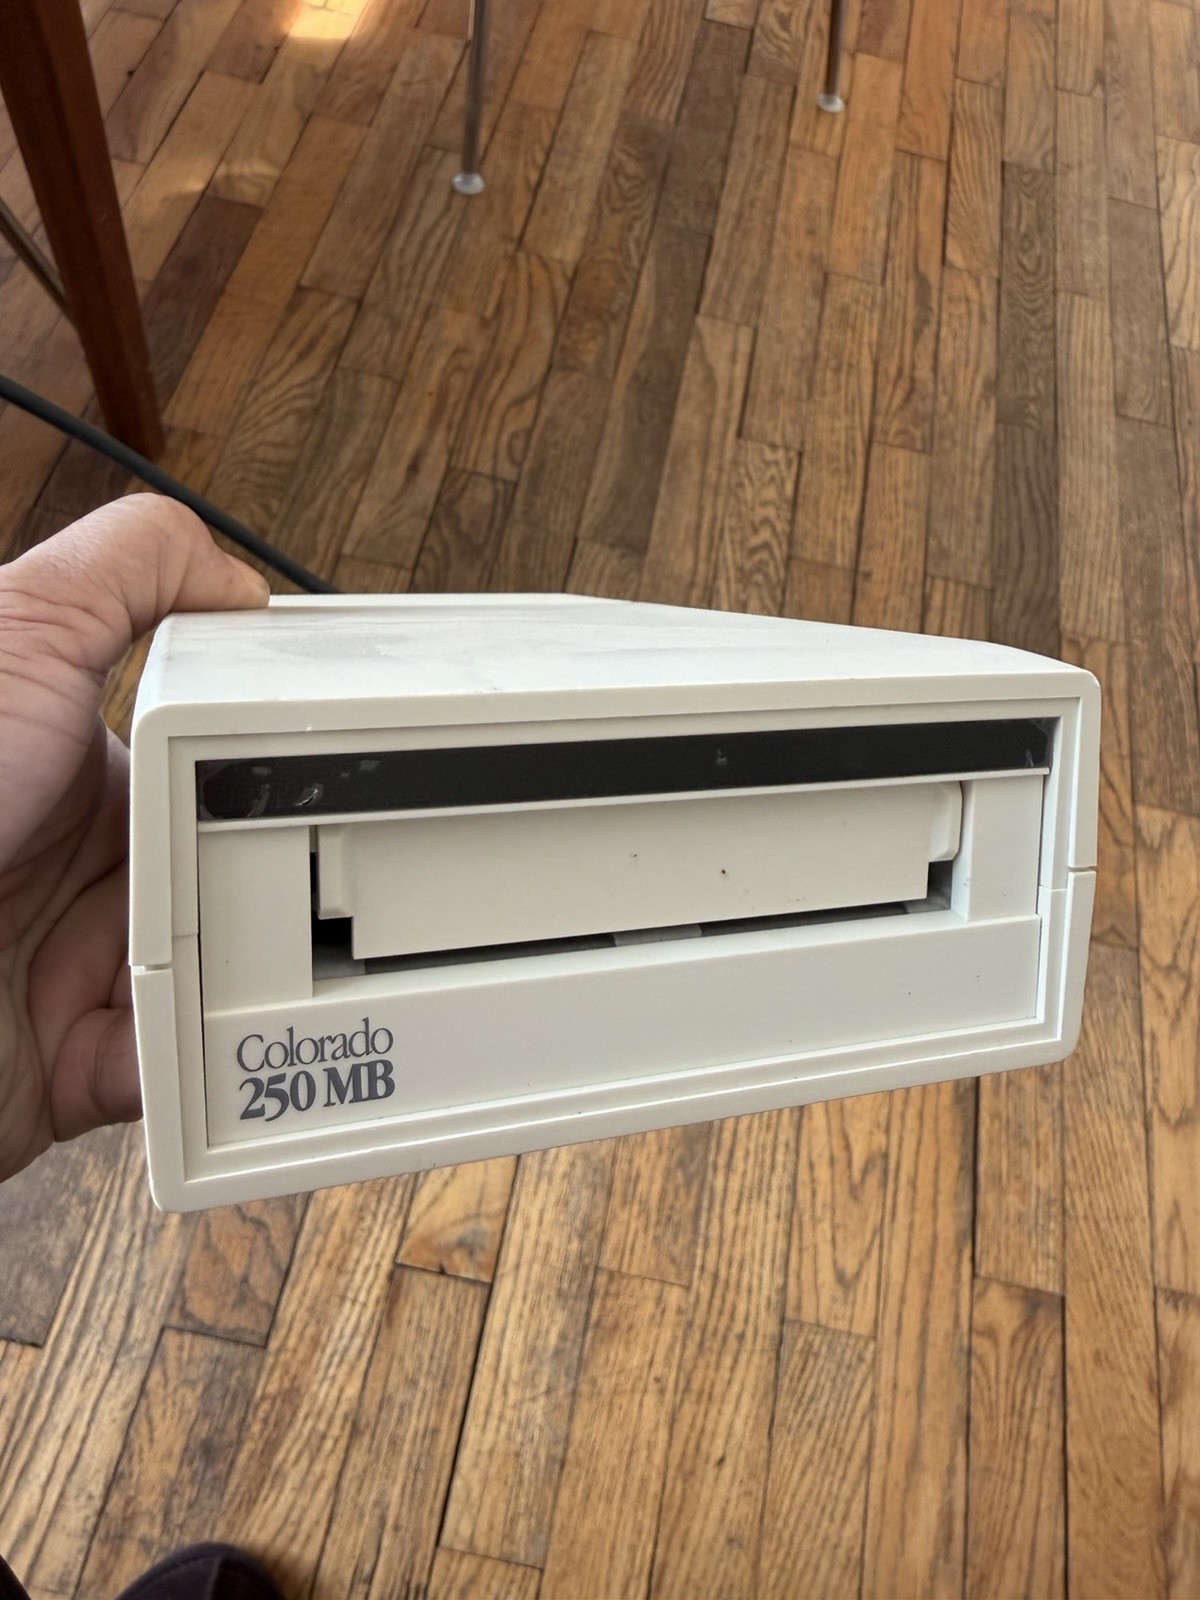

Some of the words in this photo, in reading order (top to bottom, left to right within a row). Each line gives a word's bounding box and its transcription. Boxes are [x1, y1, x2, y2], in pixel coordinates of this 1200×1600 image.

[236, 1016, 394, 1073] Colorado
[239, 1070, 317, 1122] 250
[322, 1059, 396, 1108] MB
